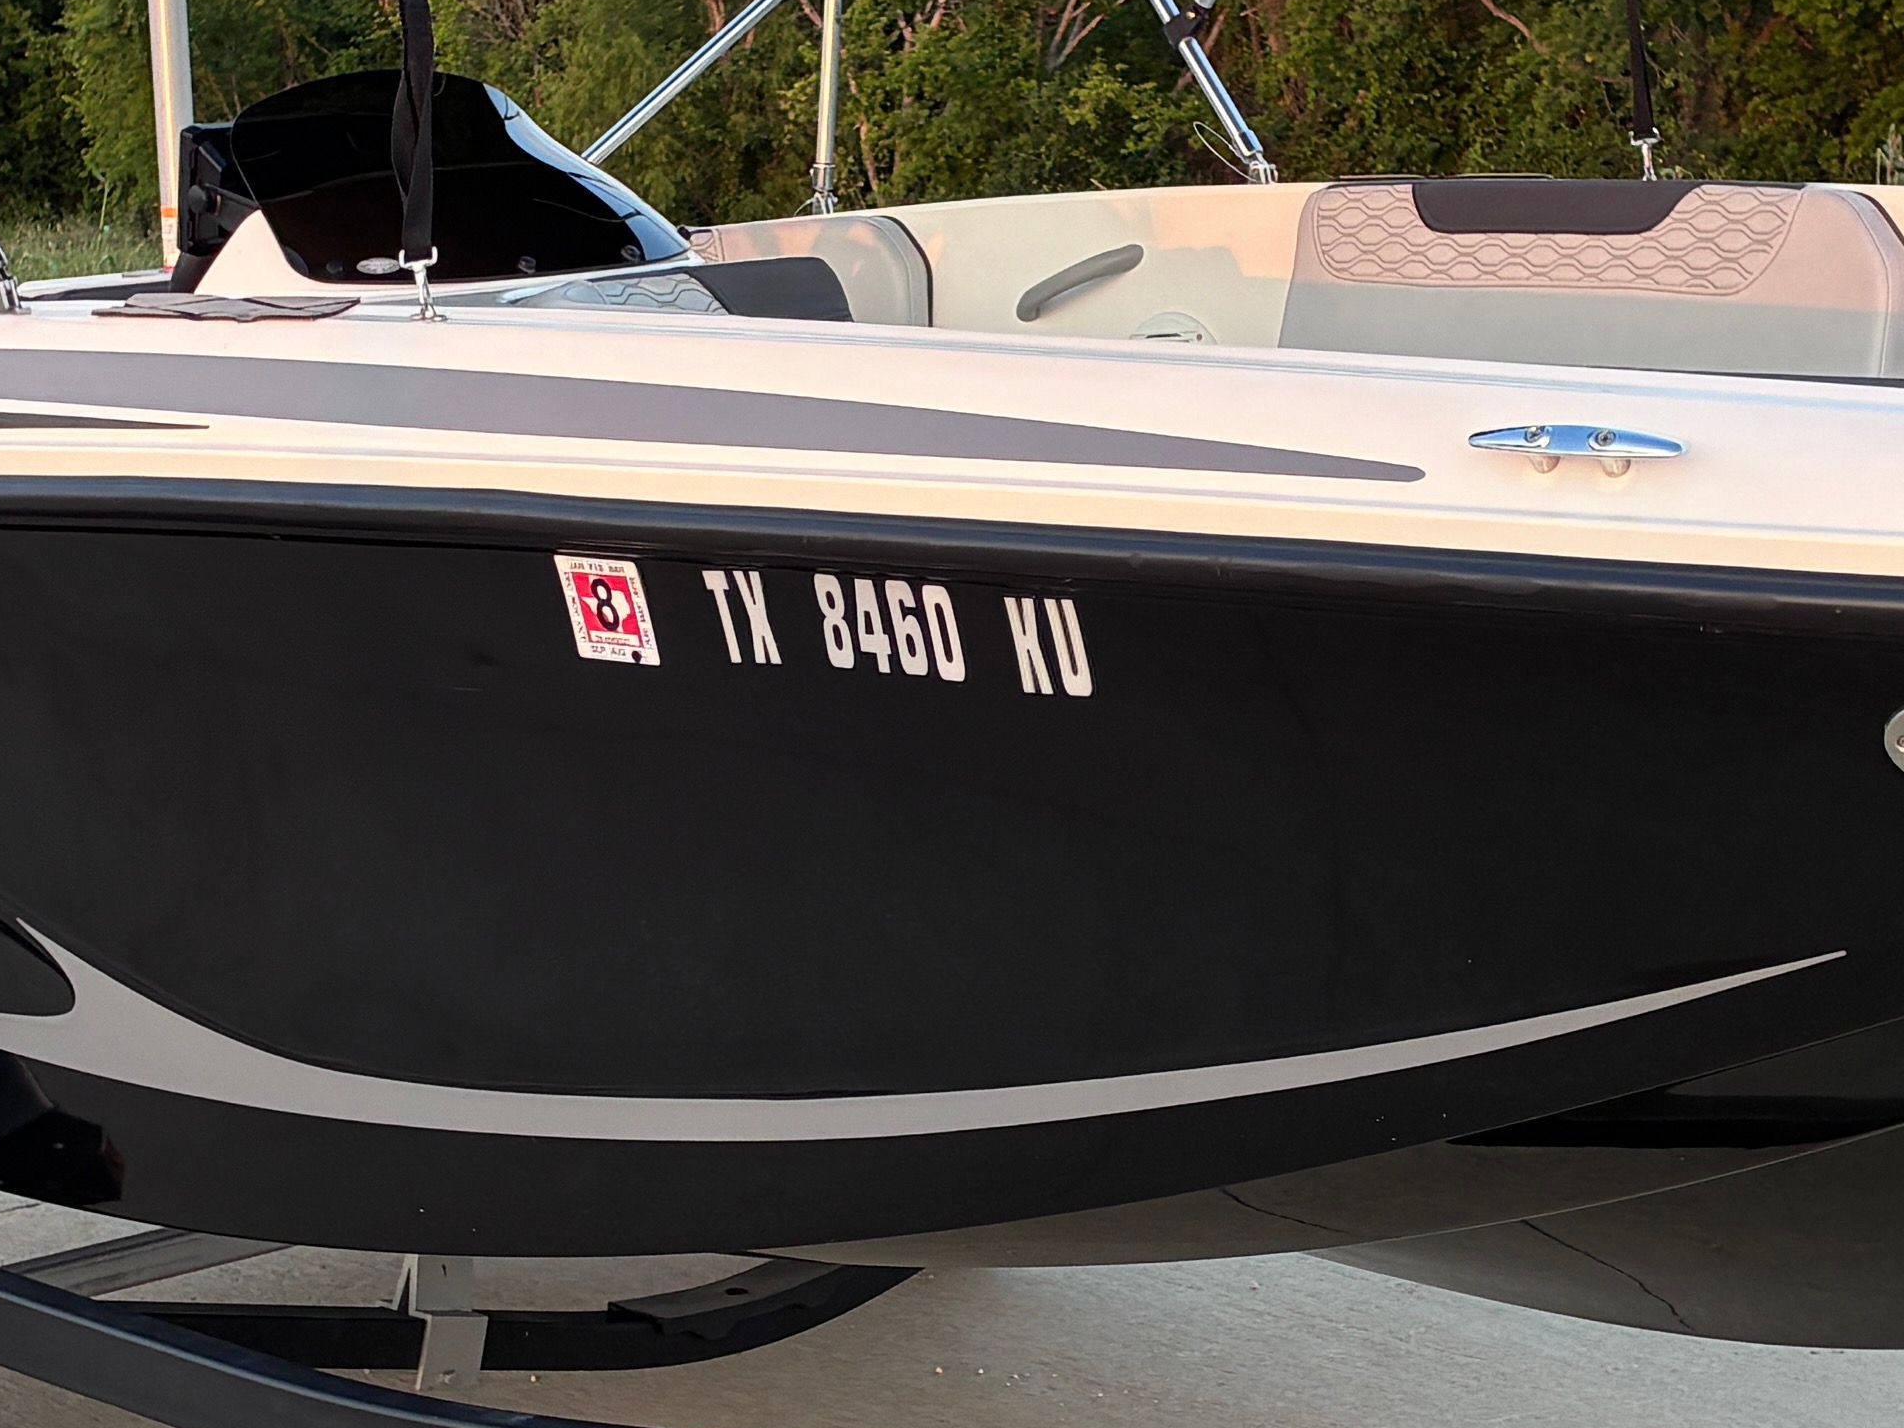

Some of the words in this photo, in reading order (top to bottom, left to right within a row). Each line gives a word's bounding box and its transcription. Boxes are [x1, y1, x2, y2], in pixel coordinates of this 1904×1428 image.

[702, 570, 783, 664] TX
[813, 573, 965, 682] 8460
[1003, 597, 1093, 697] KU
